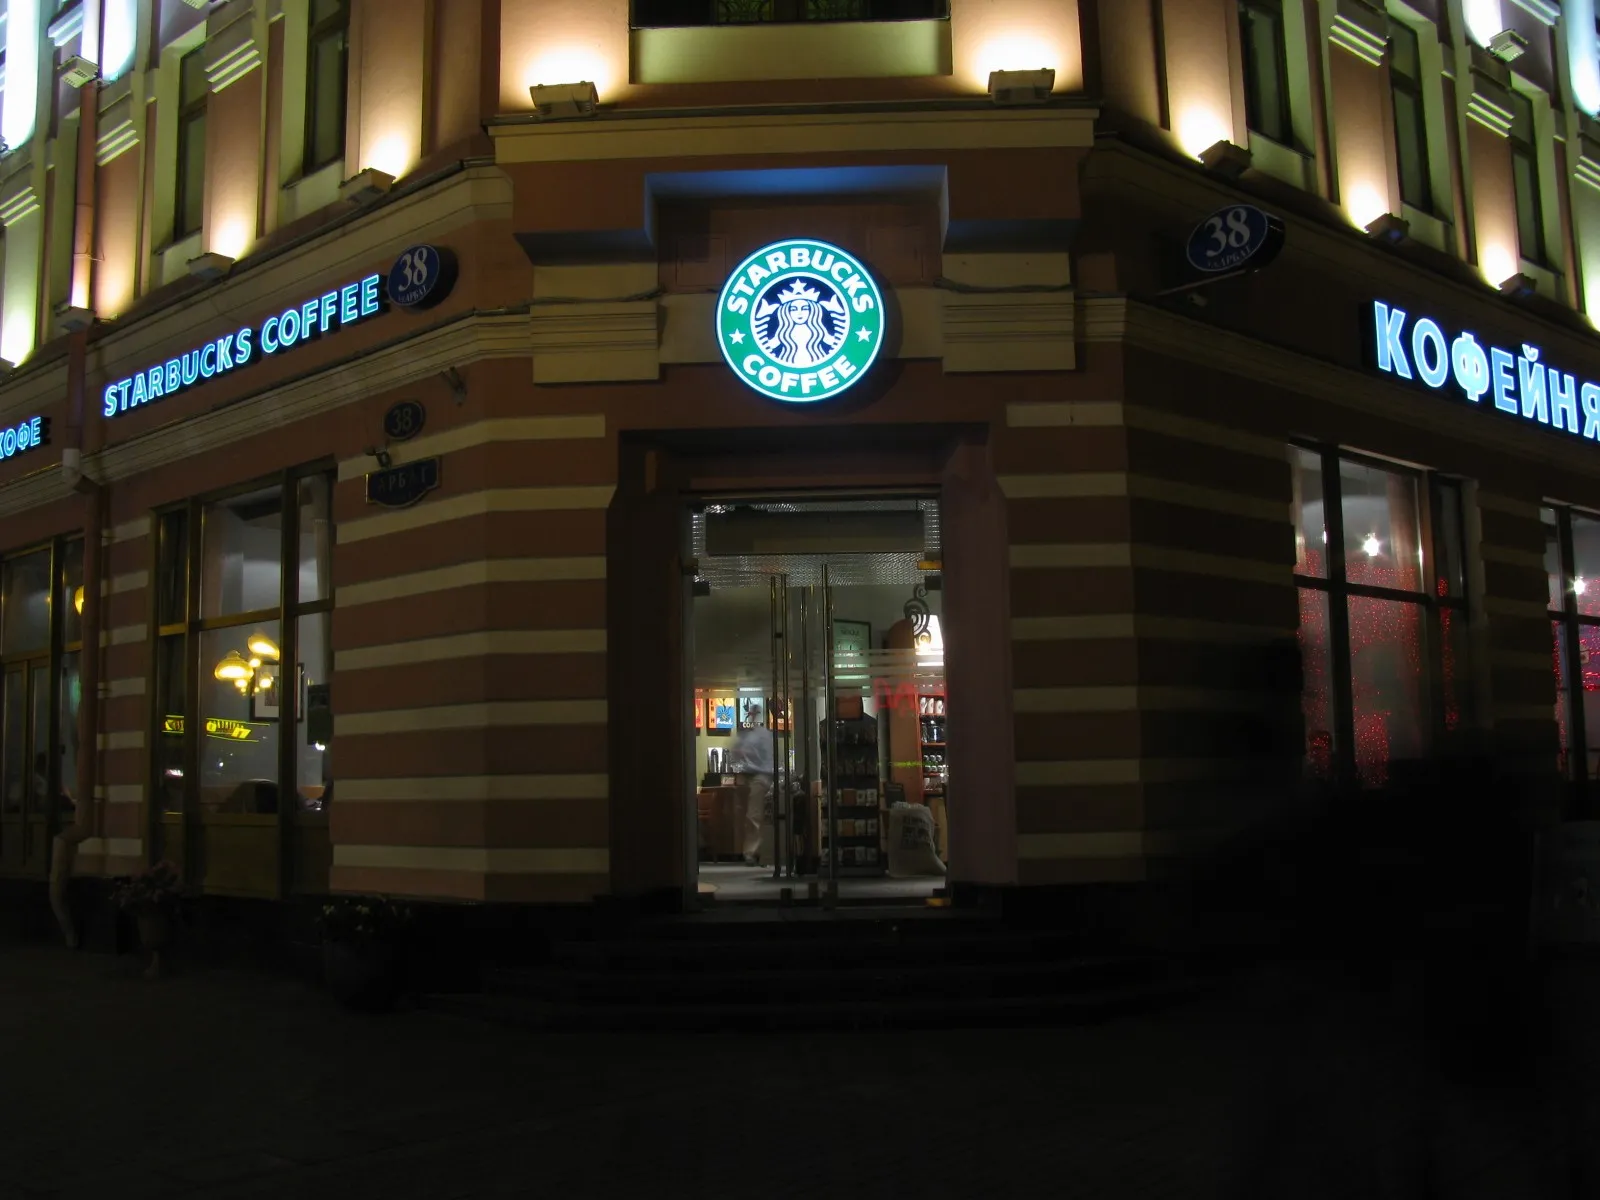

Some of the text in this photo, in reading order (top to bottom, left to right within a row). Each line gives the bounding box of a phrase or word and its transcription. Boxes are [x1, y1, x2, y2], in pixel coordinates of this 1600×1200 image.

[1204, 208, 1251, 258] 38
[398, 247, 428, 292] 38
[726, 247, 875, 315] STARBUCKS
[103, 273, 381, 418] STARBUCKS COFFEE
[1373, 299, 1600, 442] КОФЕЙНЯ
[742, 354, 857, 394] COFFEE
[392, 406, 412, 433] 38
